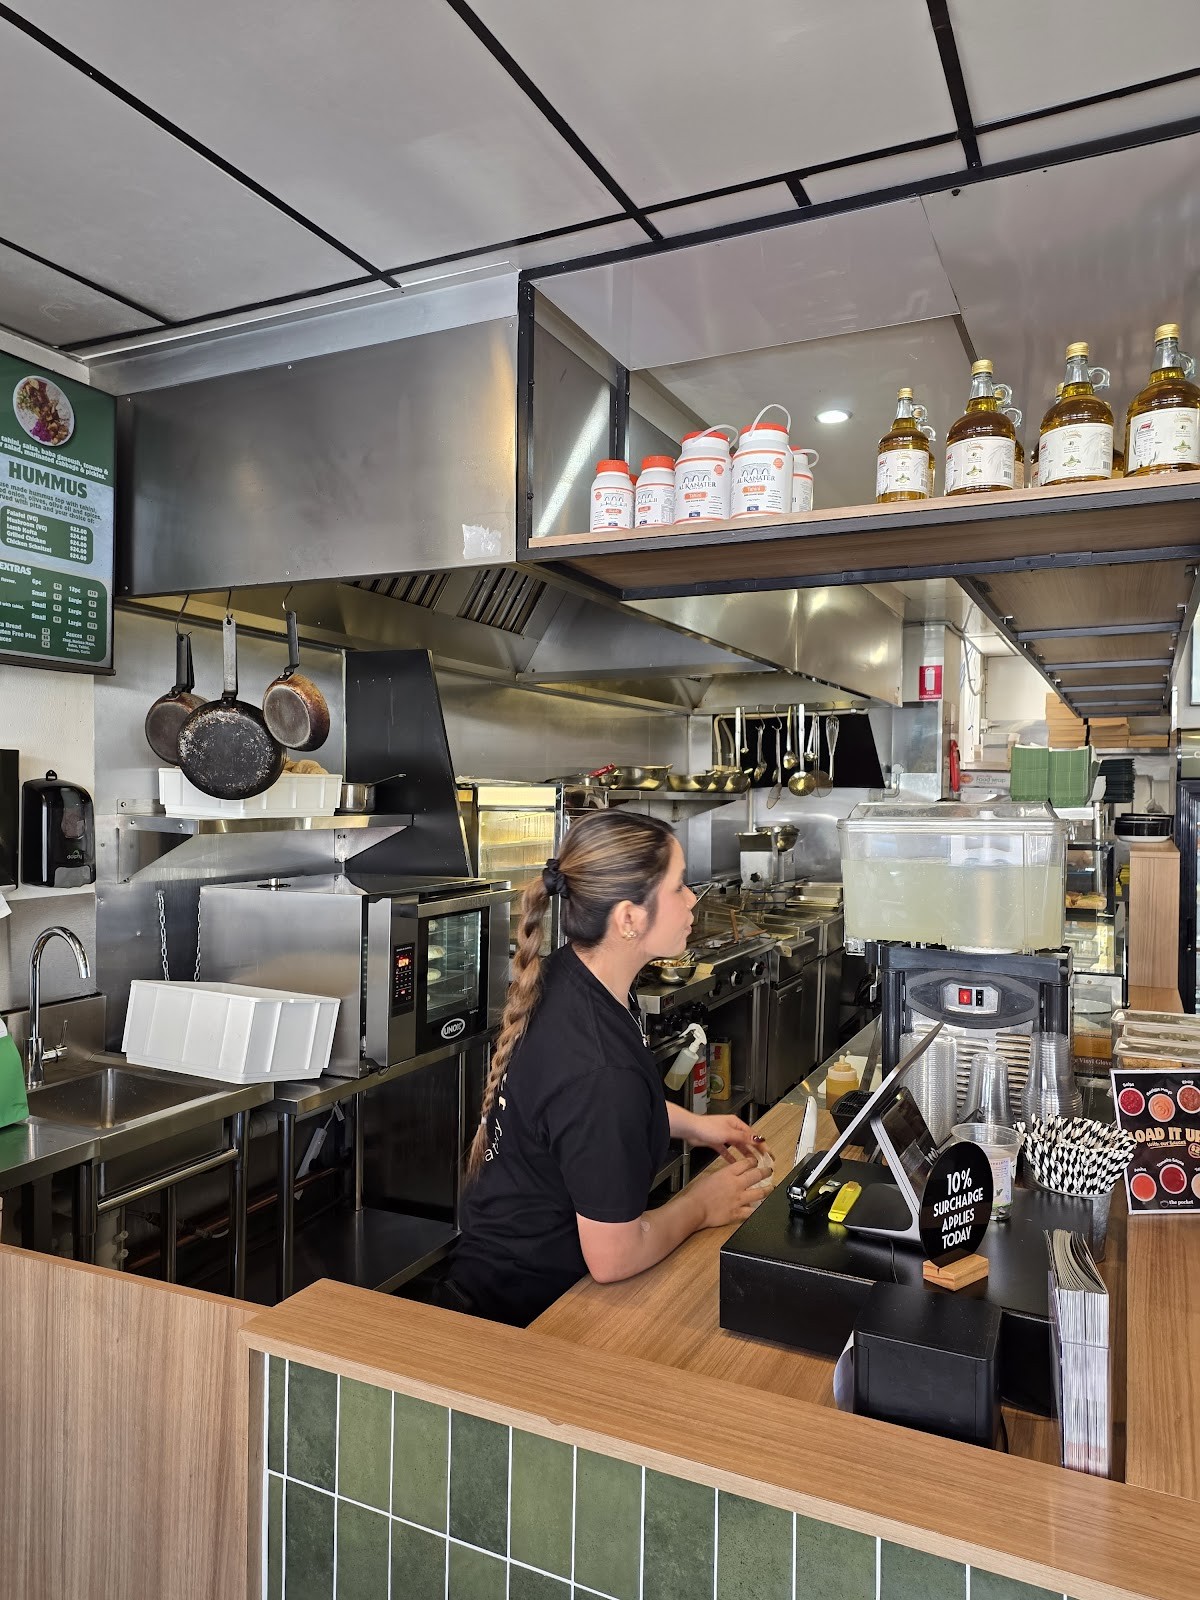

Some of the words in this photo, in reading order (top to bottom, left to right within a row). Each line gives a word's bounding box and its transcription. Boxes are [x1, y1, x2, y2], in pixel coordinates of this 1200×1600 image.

[23, 443, 40, 454] salsa,
[41, 448, 56, 458] baba
[83, 462, 102, 473] tomato
[24, 450, 54, 464] marinated
[56, 460, 79, 472] cabbage
[8, 461, 88, 499] HUMMUS
[8, 490, 27, 500] onion,
[49, 500, 63, 510] olive
[10, 485, 28, 494] made
[29, 490, 54, 501] hummus
[66, 500, 78, 508] with
[6, 508, 26, 518] Falafel
[14, 497, 28, 506] with
[30, 501, 42, 510] pita
[54, 508, 68, 517] your
[69, 512, 86, 522] choice
[6, 516, 35, 528] Mushroom
[6, 524, 22, 532] Lamb
[6, 530, 24, 540] Grilled
[26, 535, 46, 544] Chicken
[6, 538, 28, 548] Chicken
[28, 542, 52, 553] Schnitzel
[0, 562, 32, 576] EXTRAS
[32, 590, 46, 598] Small
[68, 596, 82, 605] Large
[32, 601, 46, 609] Small
[32, 612, 46, 621] Small
[6, 622, 22, 630] Bread
[1079, 1057, 1095, 1066] Vinyl
[1168, 1127, 1182, 1140] IT
[947, 1168, 972, 1196] 10%
[934, 1187, 984, 1217] SURCHARGE
[942, 1208, 975, 1232] APPLIES
[942, 1225, 972, 1249] TODAY
